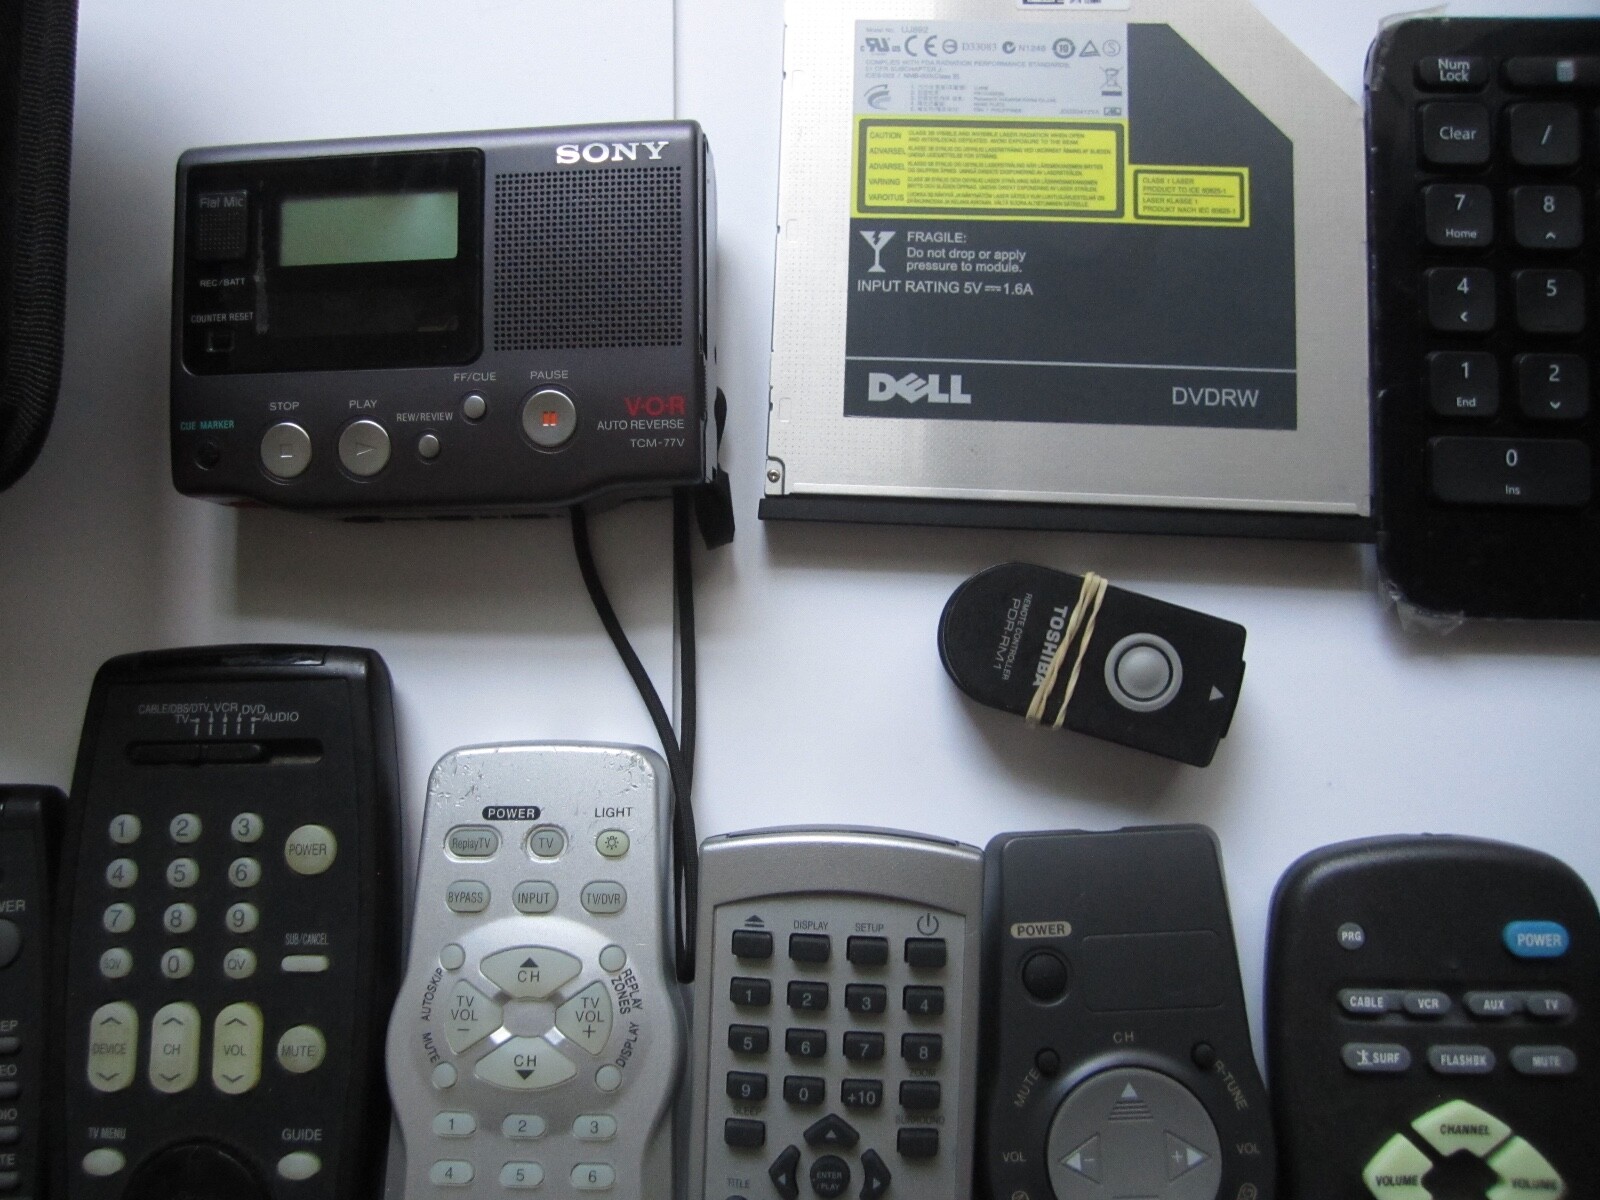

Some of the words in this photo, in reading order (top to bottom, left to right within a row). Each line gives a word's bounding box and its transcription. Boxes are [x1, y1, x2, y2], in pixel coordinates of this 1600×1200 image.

[1438, 58, 1470, 70] Num
[1439, 70, 1470, 82] Lock
[869, 132, 902, 140] CAUTION
[1439, 126, 1477, 140] Clear
[556, 141, 670, 164] SONY
[868, 178, 901, 186] VARNING
[224, 196, 244, 208] Mic
[1454, 194, 1466, 211] 7
[1542, 196, 1556, 213] 8
[907, 231, 967, 244] FRAGILE:
[1445, 228, 1477, 240] Home
[906, 247, 924, 258] Do
[926, 248, 946, 259] not
[949, 248, 975, 262] drop
[978, 251, 992, 260] or
[994, 250, 1026, 262] apply
[906, 261, 957, 272] pressure
[961, 261, 972, 272] to
[975, 261, 1022, 272] module.
[857, 280, 902, 292] INPUT
[905, 280, 960, 294] RATING
[1456, 277, 1470, 294] 4
[1546, 279, 1558, 297] 5
[190, 314, 227, 324] COUNTER
[229, 312, 254, 322] RESET
[454, 372, 497, 382] FF/CUE
[530, 370, 569, 380] PAUSE
[1460, 361, 1469, 380] 1
[1549, 364, 1561, 382] 2
[868, 372, 972, 404] DELL
[1171, 386, 1259, 408] DVDRW
[1456, 396, 1476, 408] End
[269, 402, 300, 412] STOP
[349, 400, 378, 410] PLAY
[396, 412, 454, 422] REW/REVIEW
[180, 421, 196, 432] CUE
[200, 420, 235, 430] MARKER
[596, 420, 628, 431] AUTO
[630, 419, 685, 430] REVERSE
[630, 438, 685, 448] TCM-77V
[1506, 448, 1518, 467] 0
[1505, 484, 1521, 496] Ins
[1017, 592, 1033, 628] REMOTE
[1032, 606, 1068, 686] TOSHIBA
[1002, 627, 1023, 680] CONTROLLER
[214, 702, 238, 713] VCR
[242, 704, 266, 715] DVD
[175, 714, 190, 724] TV
[262, 712, 299, 722] AUDIO
[487, 809, 535, 819] POWER
[594, 807, 633, 818] LIGHT
[117, 820, 126, 838] 1
[176, 820, 190, 837] 2
[238, 818, 250, 836] 3
[289, 843, 327, 856] POWER
[452, 838, 491, 850] ReplayTV
[538, 838, 554, 849] TV
[112, 864, 125, 882] 4
[173, 864, 186, 882] 5
[236, 864, 248, 882] 6
[448, 892, 483, 904] BYPASS
[518, 892, 550, 904] INPUT
[586, 893, 621, 905] TV/DVR
[110, 910, 123, 927] 7
[170, 910, 182, 928] 8
[232, 910, 245, 928] 9
[794, 920, 828, 930] DISPLAY
[855, 922, 884, 932] SETUP
[1016, 924, 1065, 937] POWER
[284, 932, 329, 946] SUB/CANCEL
[1341, 931, 1362, 942] PRG
[1517, 933, 1562, 947] POWER
[167, 955, 180, 974] 0
[227, 958, 246, 971] QV
[517, 970, 540, 982] CH
[421, 967, 445, 1022] AUTOSKIP
[610, 976, 630, 1015] ZONES
[622, 968, 644, 1010] REPLAY
[456, 995, 474, 1008] TV
[581, 996, 600, 1009] TV
[746, 990, 752, 1002] 1
[802, 993, 811, 1006] 2
[1350, 996, 1384, 1008] CABLE
[862, 997, 871, 1010] 3
[920, 999, 929, 1012] 4
[1418, 998, 1440, 1009] VCR
[1483, 999, 1505, 1010] AUX
[1544, 1000, 1559, 1010] TV
[451, 1009, 478, 1022] VOL
[575, 1010, 605, 1023] VOL
[743, 1036, 752, 1050] 5
[1113, 1031, 1134, 1043] CH
[92, 1044, 127, 1056] DEVICE
[163, 1044, 181, 1055] CH
[224, 1044, 247, 1056] VOL
[281, 1044, 316, 1058] MUTE
[422, 1032, 441, 1064] MUTE
[616, 1022, 640, 1068] DISPLAY
[802, 1041, 810, 1054] 6
[860, 1044, 870, 1056] 7
[919, 1046, 928, 1060] 8
[1372, 1052, 1400, 1064] SURF
[514, 1055, 537, 1068] CH
[1440, 1054, 1487, 1066] FLASHBK
[1532, 1056, 1561, 1068] MUTE
[742, 1084, 751, 1097] 9
[800, 1088, 808, 1101] 0
[1014, 1068, 1041, 1108] MUTE
[848, 1091, 876, 1105] +10
[449, 1118, 454, 1130] 1
[518, 1120, 527, 1132] 2
[590, 1121, 599, 1134] 3
[1440, 1124, 1490, 1136] CHANNEL
[88, 1126, 100, 1139] TV
[101, 1128, 127, 1140] MENU
[281, 1128, 323, 1142] GUIDE
[1236, 1143, 1260, 1155] VOL
[1002, 1152, 1026, 1163] VOL
[444, 1166, 454, 1180] 4
[516, 1169, 525, 1182] 5
[588, 1170, 597, 1183] 6
[816, 1171, 842, 1180] ENTER
[728, 1178, 750, 1188] TITLE
[1375, 1175, 1418, 1188] VOLUME
